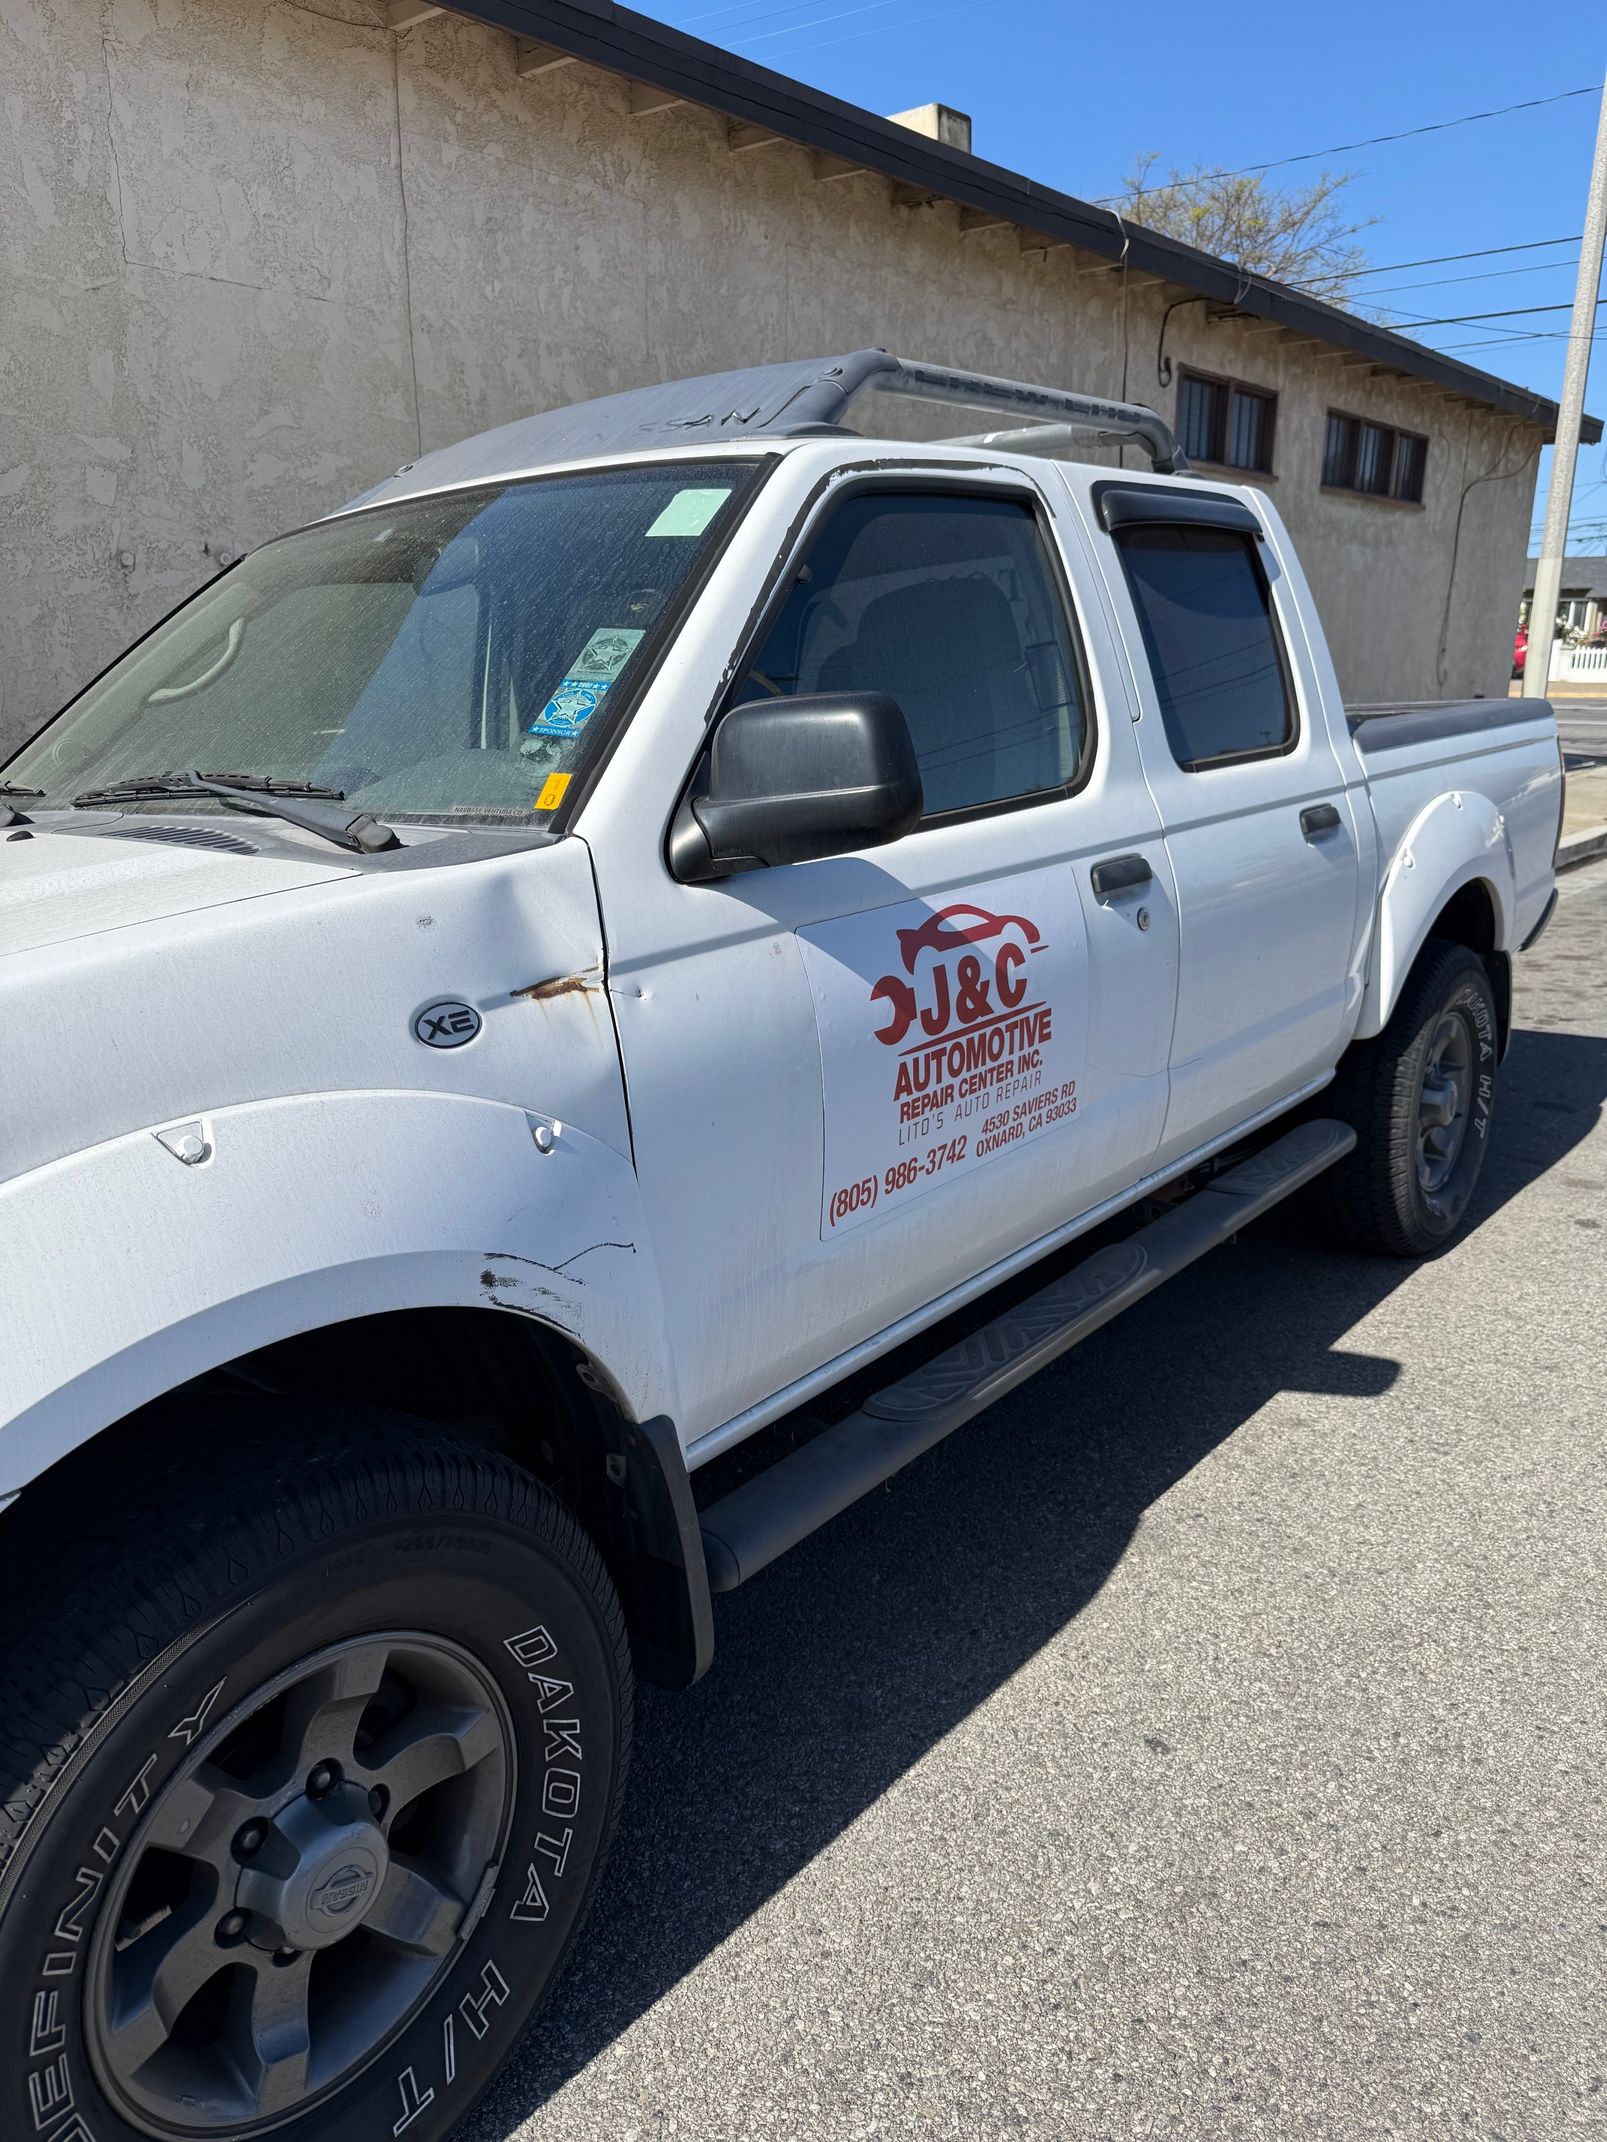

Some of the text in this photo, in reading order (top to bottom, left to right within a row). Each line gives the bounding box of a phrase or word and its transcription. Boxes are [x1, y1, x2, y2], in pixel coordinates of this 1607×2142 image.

[539, 727, 571, 736] SPONSOR
[484, 807, 512, 815] VENTURA
[421, 1009, 476, 1041] XE
[920, 942, 1028, 1036] J&C
[893, 1008, 1052, 1102] AUTOMOTIVE
[899, 1048, 1043, 1124] REPAIR CENTER INC.
[898, 1070, 1042, 1146] LITO'S AUTO REPAIR
[976, 1097, 1077, 1158] OXNARD, CA 93033
[981, 1080, 1076, 1136] 4530 SAVIERS RD
[829, 1134, 968, 1227] (805) 986-3742
[393, 1624, 583, 2138] DAKOTA H/T
